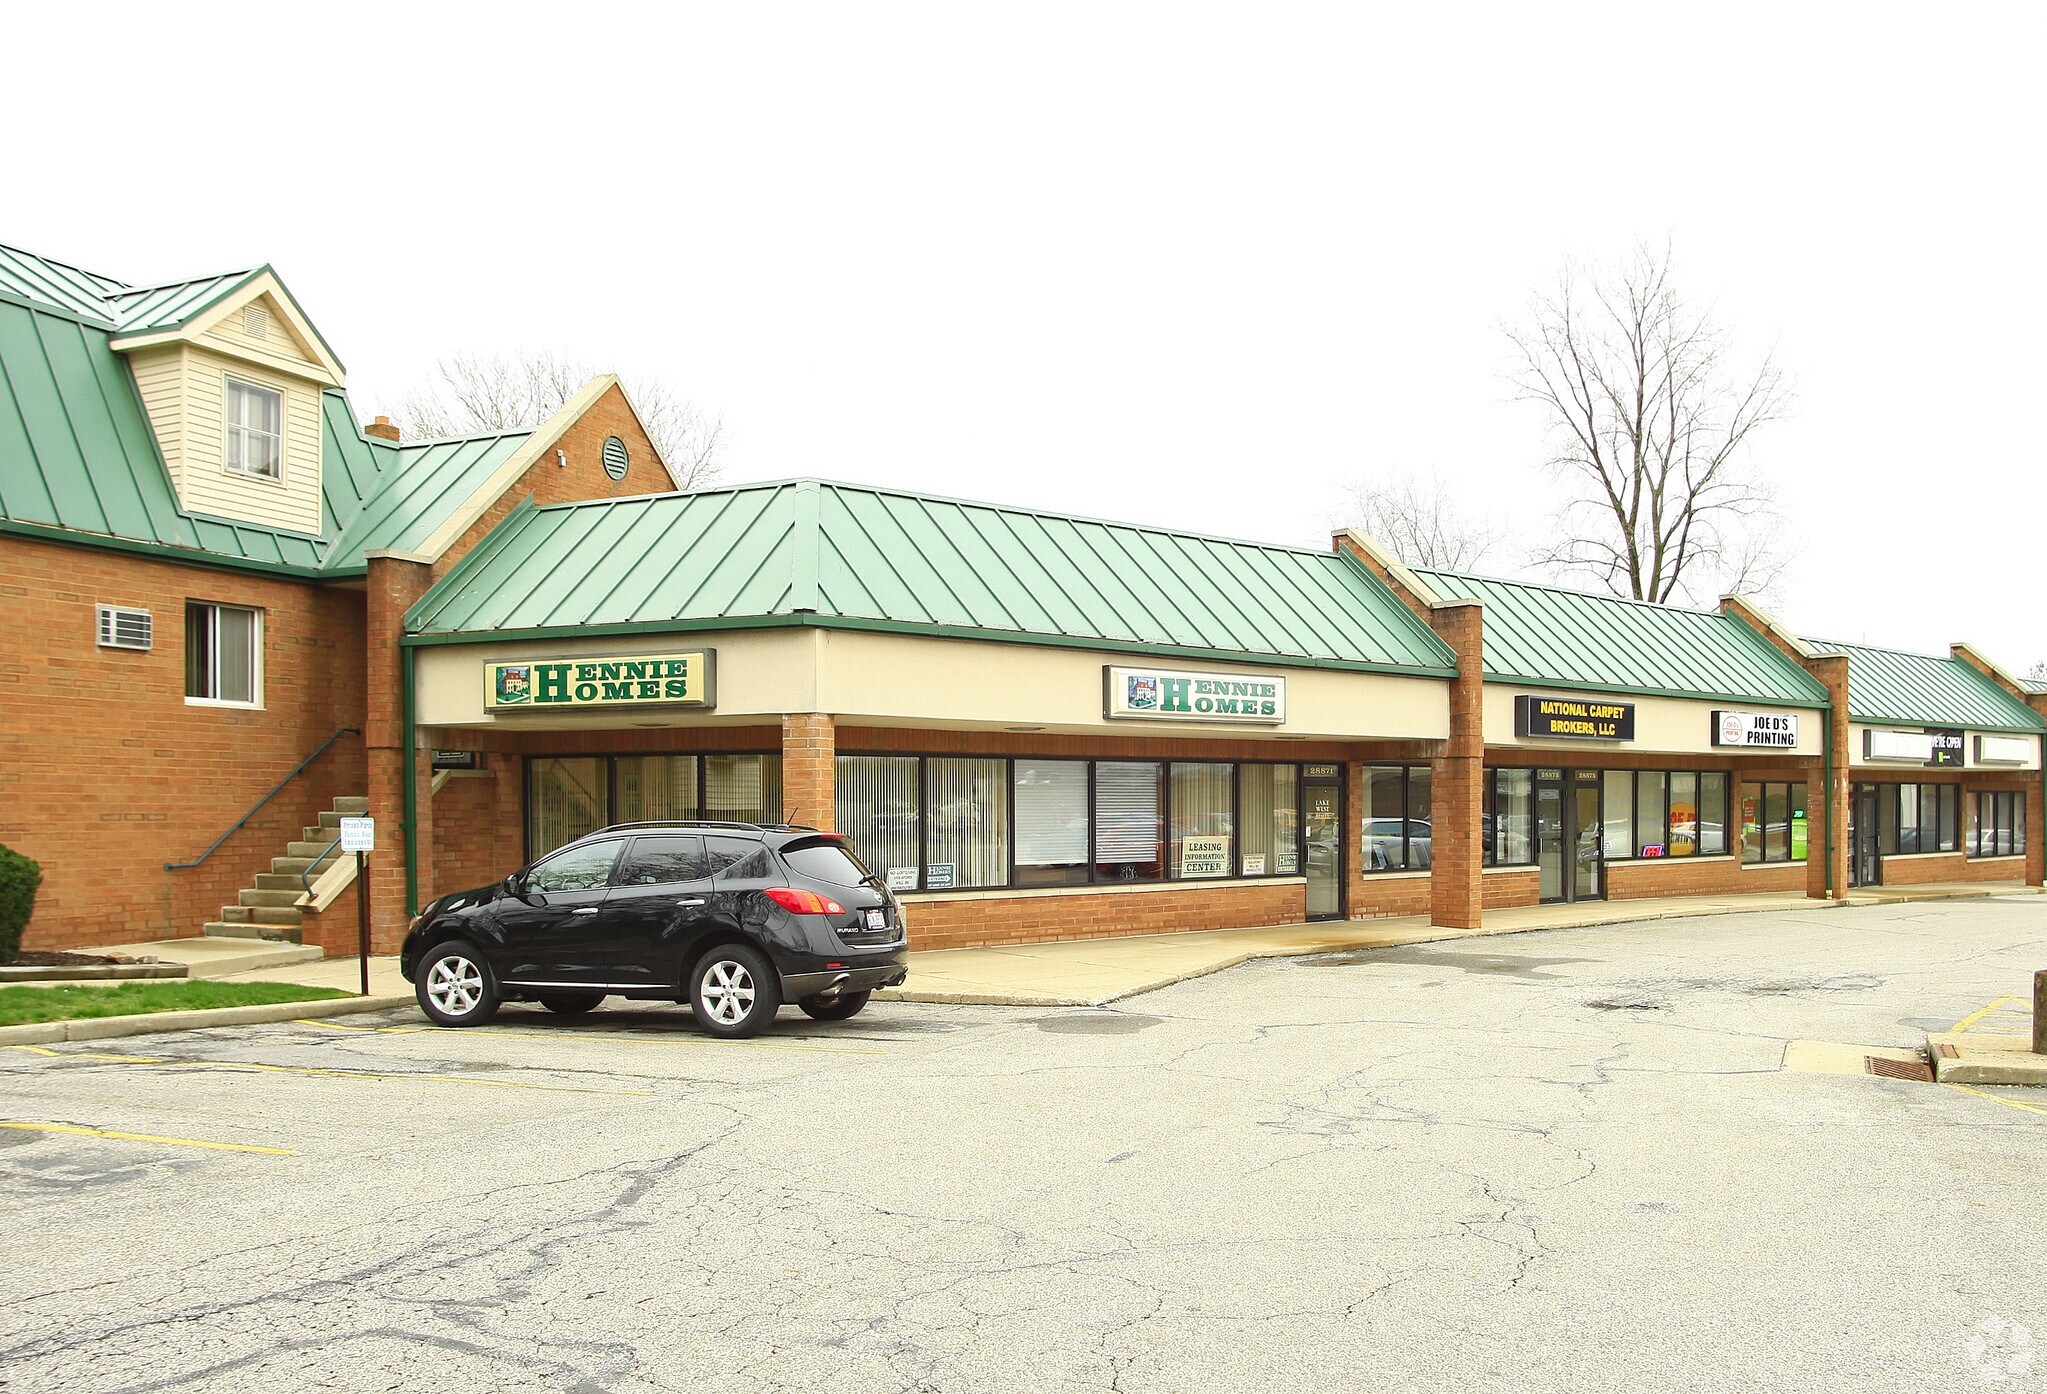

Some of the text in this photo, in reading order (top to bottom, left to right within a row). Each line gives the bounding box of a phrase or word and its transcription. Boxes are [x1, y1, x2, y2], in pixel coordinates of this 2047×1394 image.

[534, 660, 688, 703] HENNIE
[1160, 678, 1276, 712] HENNIE
[1540, 701, 1625, 719] NATIONAL CARPET
[1550, 719, 1616, 737] BROKERS, LLC
[1754, 716, 1788, 730] JOE D'S
[1747, 731, 1794, 745] PRINTING
[1932, 735, 1962, 749] E'RE OPEN
[1310, 767, 1334, 775] 28871
[1188, 843, 1222, 852] LEASING
[1186, 862, 1221, 872] CENTER
